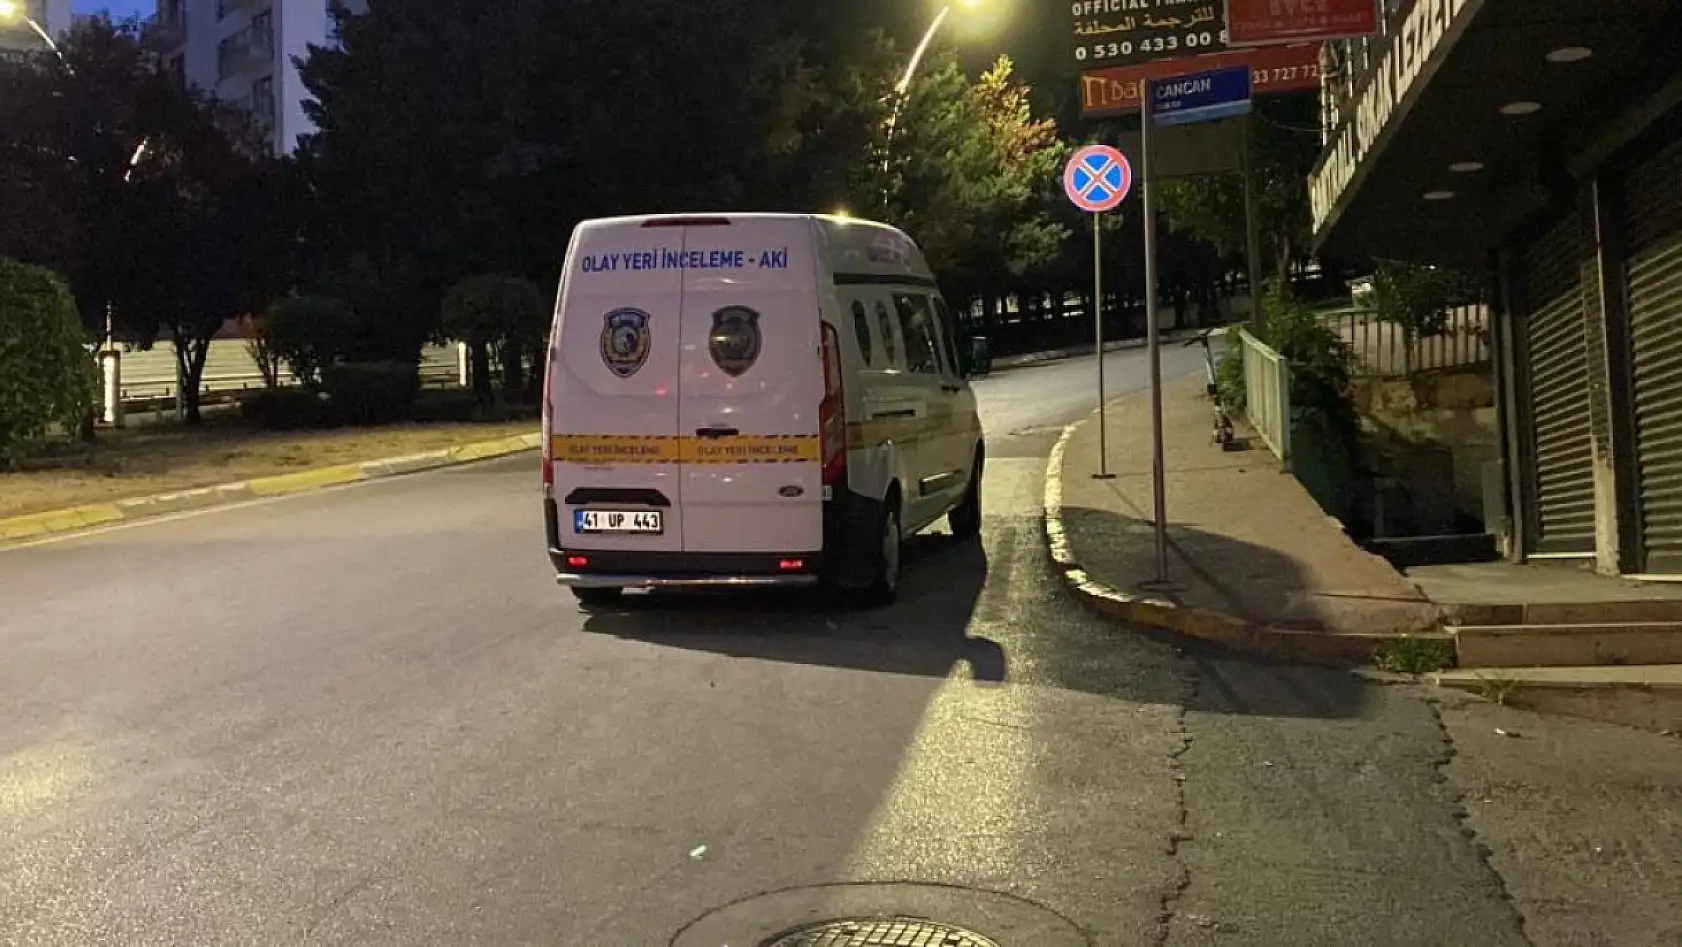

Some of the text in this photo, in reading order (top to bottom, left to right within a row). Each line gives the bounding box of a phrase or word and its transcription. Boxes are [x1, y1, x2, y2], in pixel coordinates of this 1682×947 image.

[1075, 47, 1087, 60] 0
[1094, 41, 1132, 59] 530
[1140, 36, 1178, 52] 433
[1185, 31, 1211, 47] 00
[1156, 77, 1211, 99] CANCAN
[582, 253, 619, 273] OLAY
[619, 248, 658, 270] YERİ
[662, 247, 743, 269] İNCELEME
[759, 247, 788, 269] AKİ
[584, 512, 658, 528] 41 UP 443
